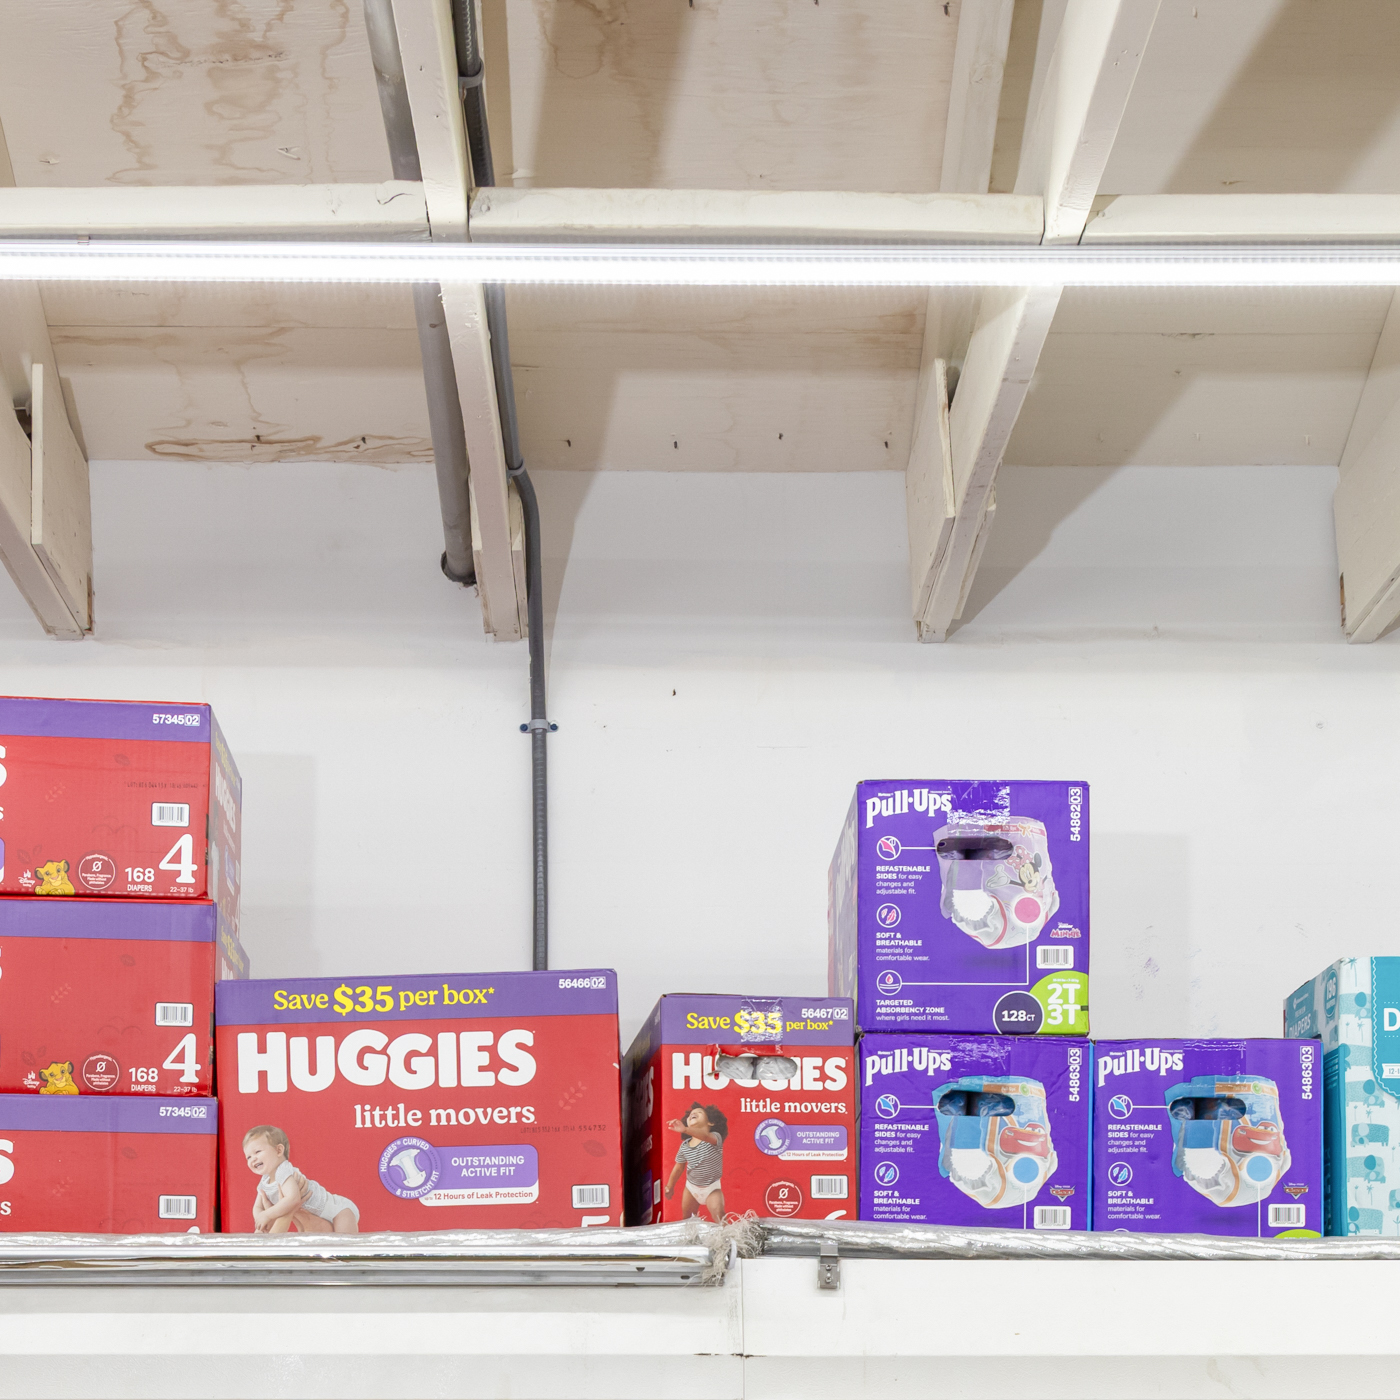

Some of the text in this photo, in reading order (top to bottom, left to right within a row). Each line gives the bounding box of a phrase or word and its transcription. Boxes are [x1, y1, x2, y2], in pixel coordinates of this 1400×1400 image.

[158, 834, 198, 884] 4
[125, 868, 155, 883] 168
[273, 990, 328, 1010] Save
[333, 983, 394, 1016] $35
[399, 987, 438, 1011] per
[1047, 983, 1080, 1004] 2T
[686, 1012, 730, 1029] Save
[734, 1010, 782, 1036] $35
[786, 1020, 805, 1032] per
[1047, 1004, 1080, 1025] 3T
[237, 1029, 537, 1093] HUGGIES
[354, 1103, 535, 1128] little movers
[741, 1098, 847, 1113] little movers
